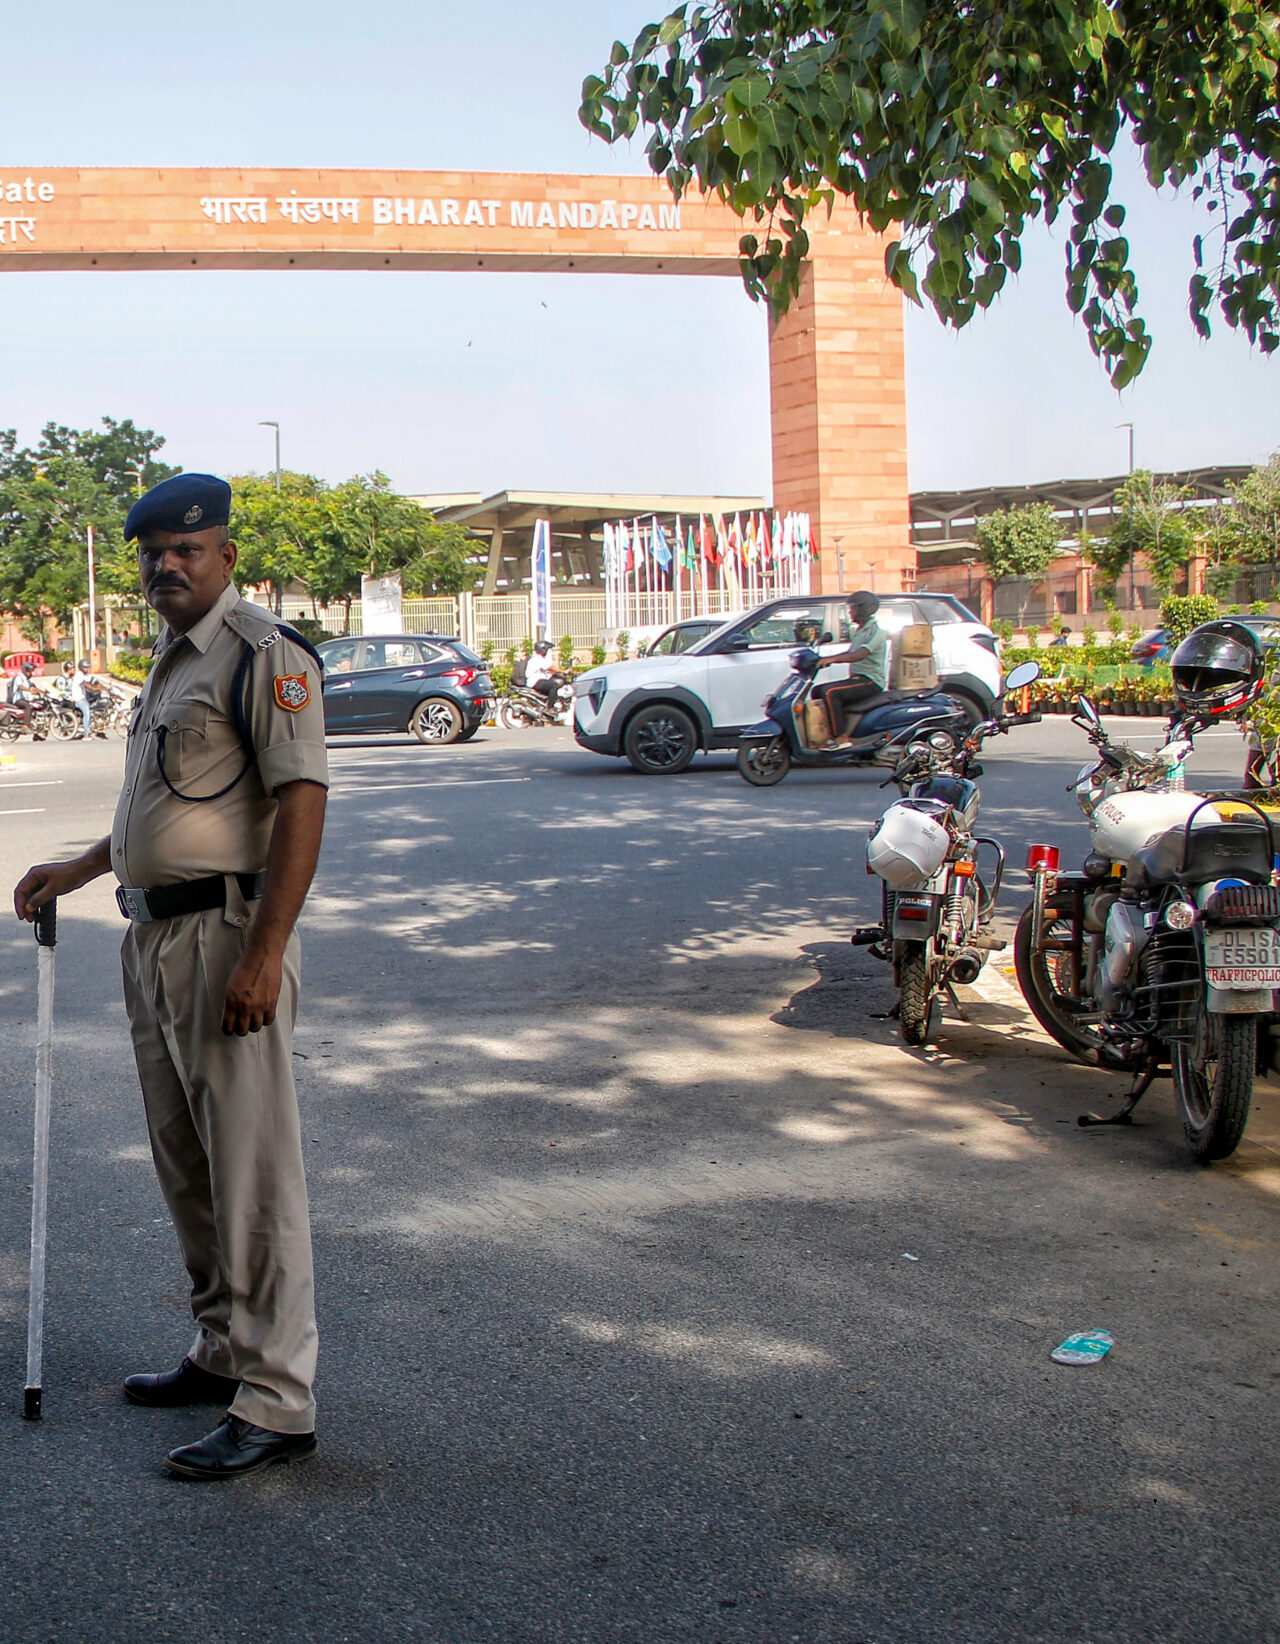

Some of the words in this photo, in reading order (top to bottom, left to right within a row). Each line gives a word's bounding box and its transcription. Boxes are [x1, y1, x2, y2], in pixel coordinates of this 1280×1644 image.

[200, 197, 268, 224] भारत
[275, 189, 360, 224] मंडपम
[373, 197, 502, 226] BHARAT
